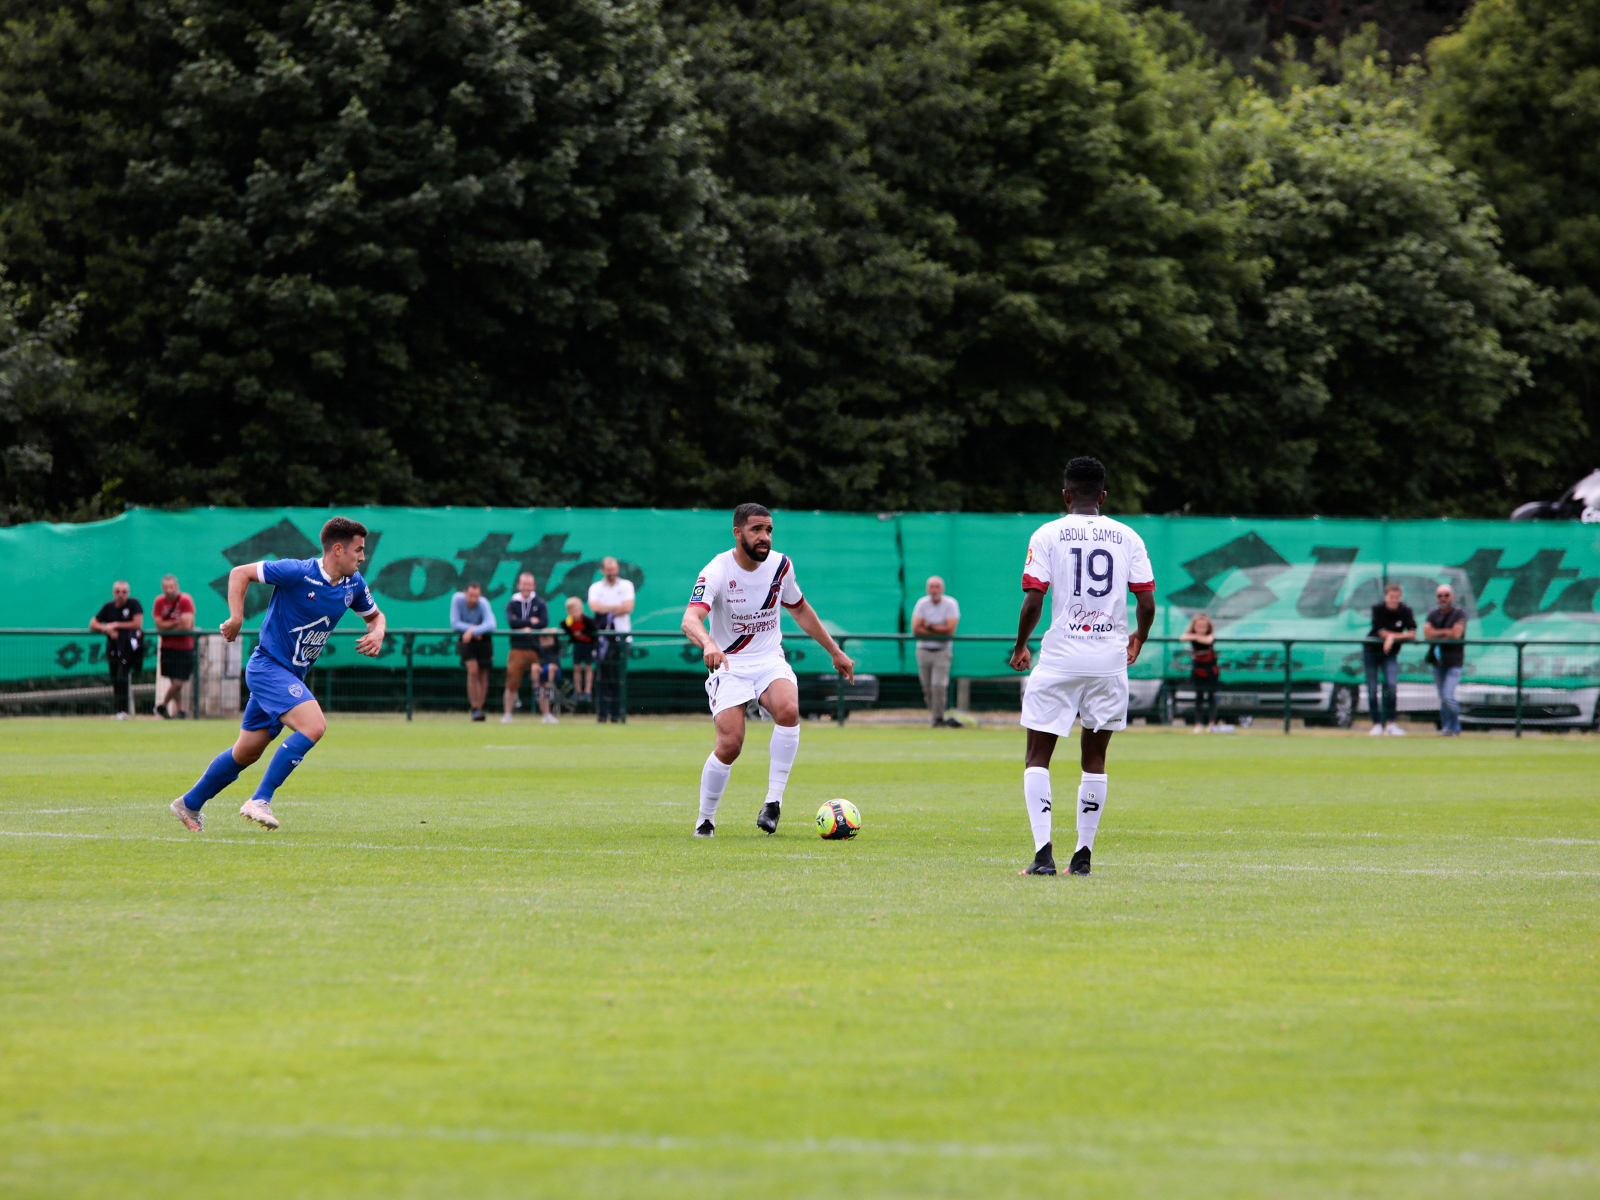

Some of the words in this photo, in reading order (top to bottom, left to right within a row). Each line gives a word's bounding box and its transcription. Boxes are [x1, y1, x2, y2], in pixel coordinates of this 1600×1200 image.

[1060, 528, 1089, 542] ABDUL
[1092, 528, 1123, 544] SAMED
[1069, 547, 1114, 598] 19
[731, 613, 753, 621] Crédit
[1088, 792, 1095, 800] 19
